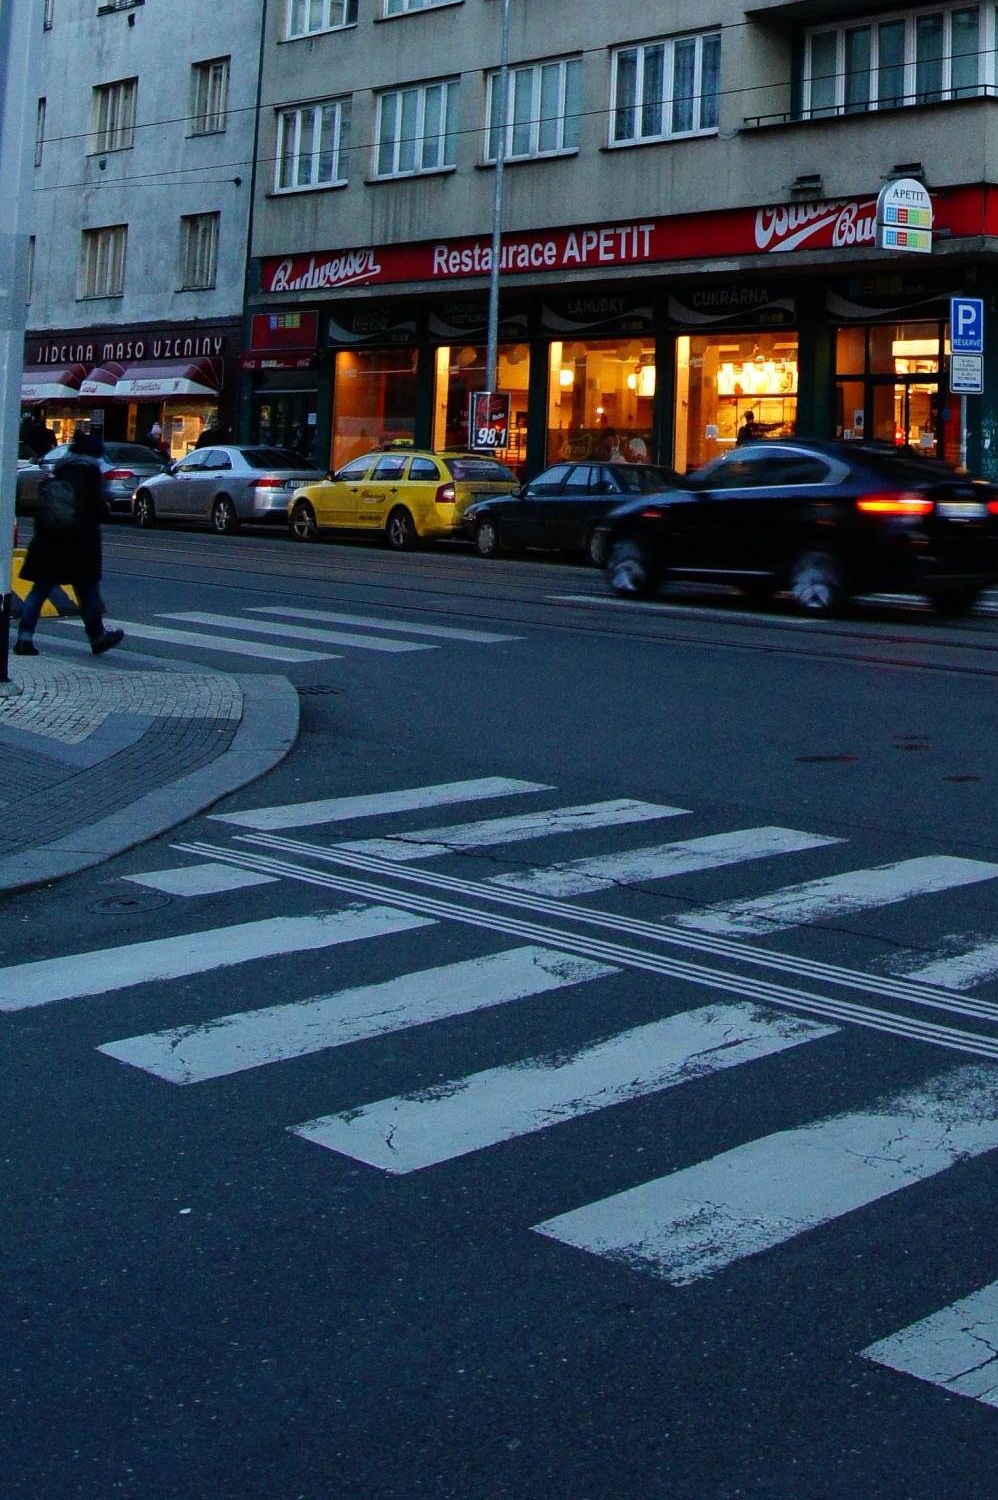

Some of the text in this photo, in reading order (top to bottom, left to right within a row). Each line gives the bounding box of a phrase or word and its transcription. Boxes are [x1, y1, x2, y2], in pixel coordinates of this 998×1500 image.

[892, 188, 925, 201] APETIT
[432, 224, 656, 275] Restaurace APETIT
[958, 304, 977, 336] P
[102, 341, 144, 360] MASO
[153, 337, 222, 357] UZENINY
[476, 427, 506, 447] 98,1
